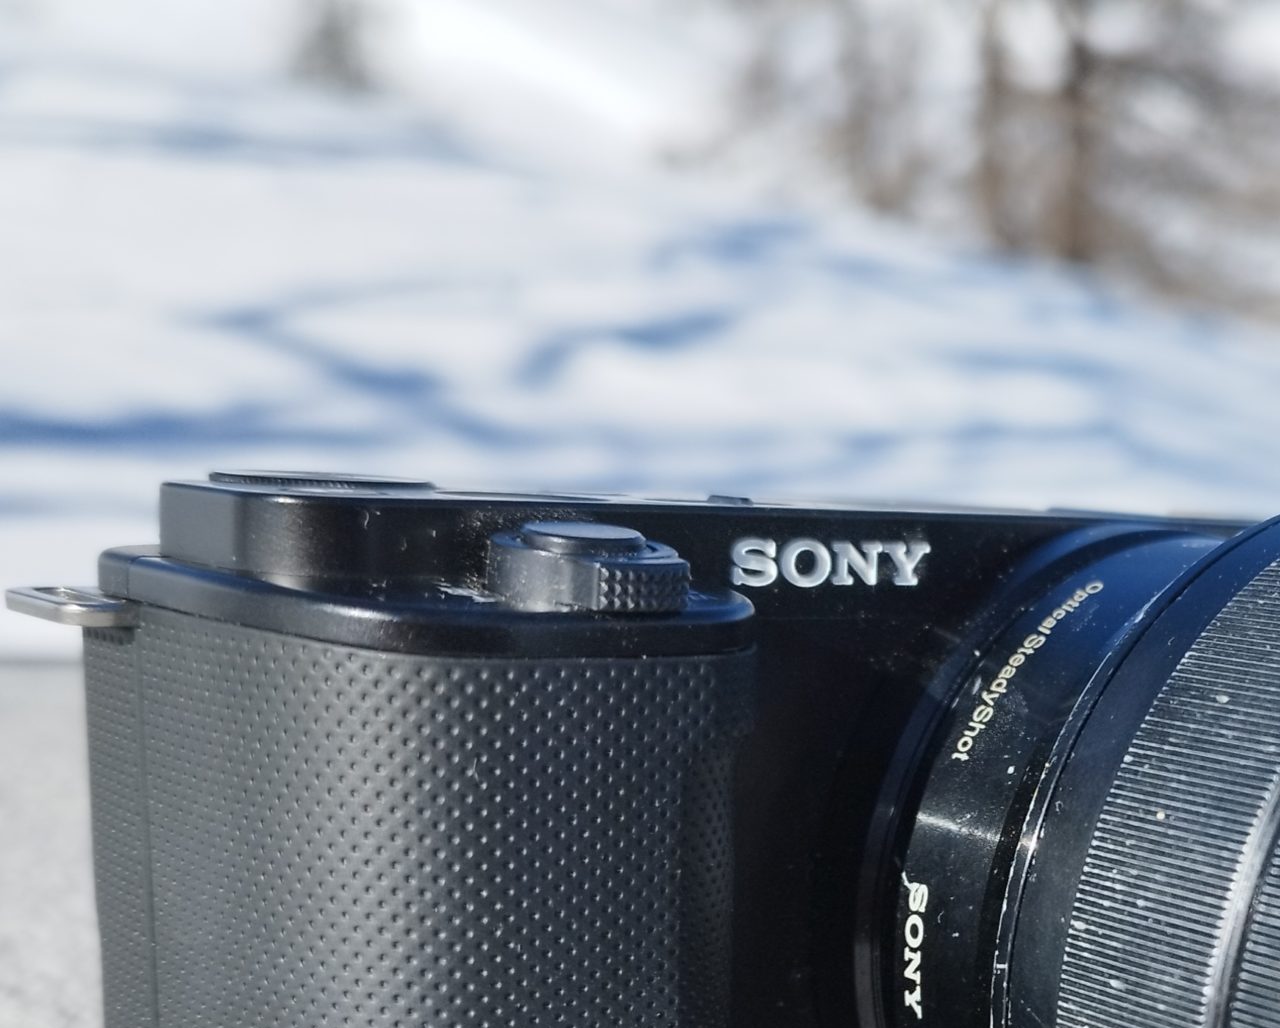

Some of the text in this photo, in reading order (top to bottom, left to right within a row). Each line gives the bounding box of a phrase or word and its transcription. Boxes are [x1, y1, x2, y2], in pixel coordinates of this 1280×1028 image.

[731, 537, 932, 588] SONY
[951, 580, 1105, 762] Optical SteadyShot
[903, 880, 930, 1020] SONY
